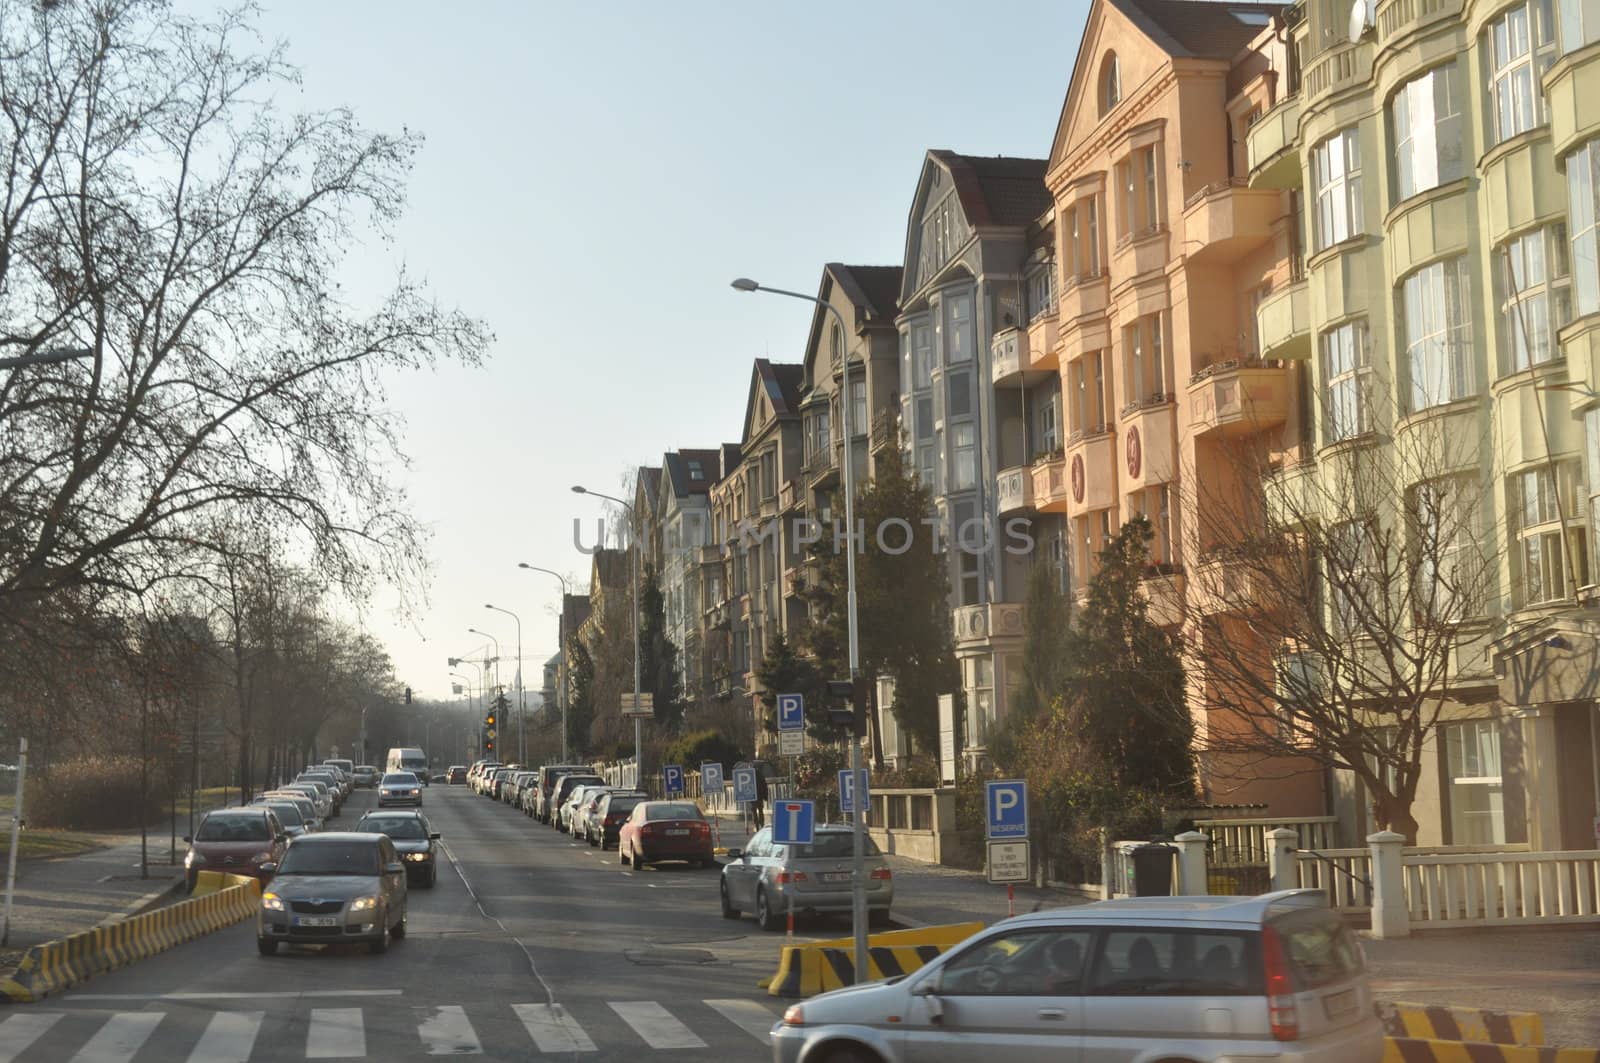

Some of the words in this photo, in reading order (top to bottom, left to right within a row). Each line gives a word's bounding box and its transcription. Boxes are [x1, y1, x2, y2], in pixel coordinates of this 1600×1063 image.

[783, 699, 798, 719] P
[667, 769, 678, 785] P
[705, 767, 718, 785] P
[737, 773, 750, 792] P
[995, 788, 1018, 821] P
